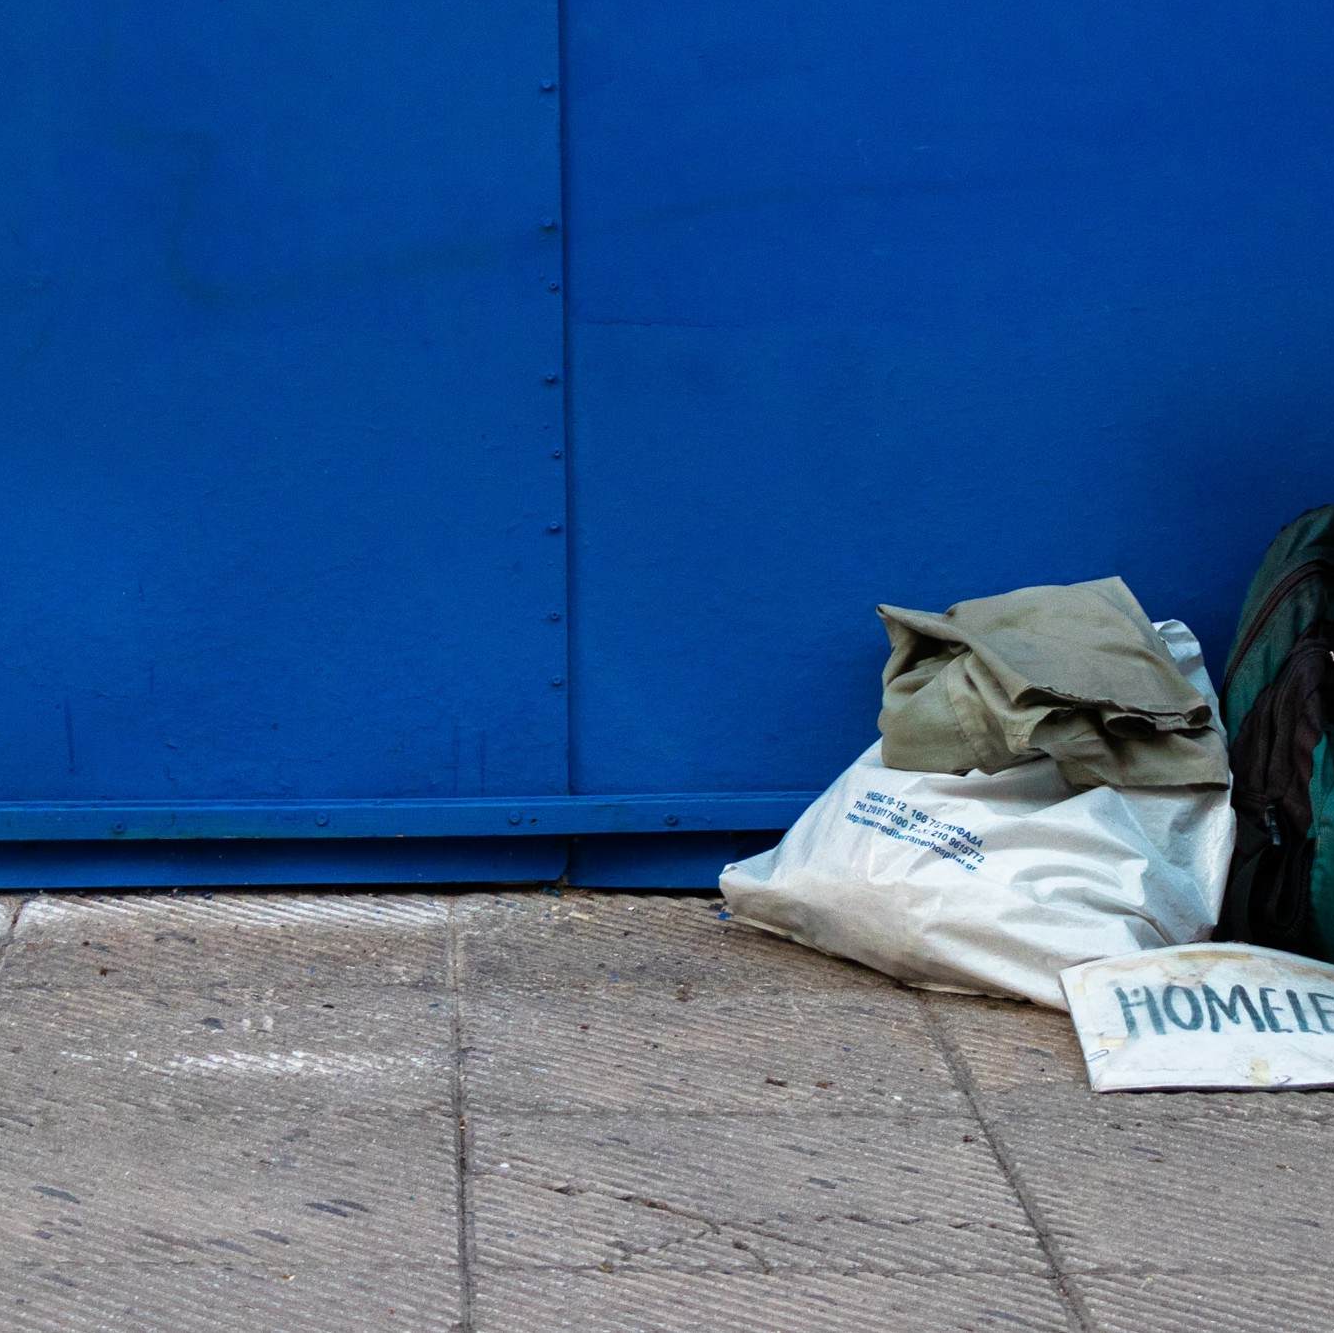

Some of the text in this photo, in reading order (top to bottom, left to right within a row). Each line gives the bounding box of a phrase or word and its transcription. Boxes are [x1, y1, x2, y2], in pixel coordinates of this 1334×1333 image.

[911, 809, 928, 823] 166
[931, 830, 948, 841] 210
[948, 837, 985, 863] 9615772
